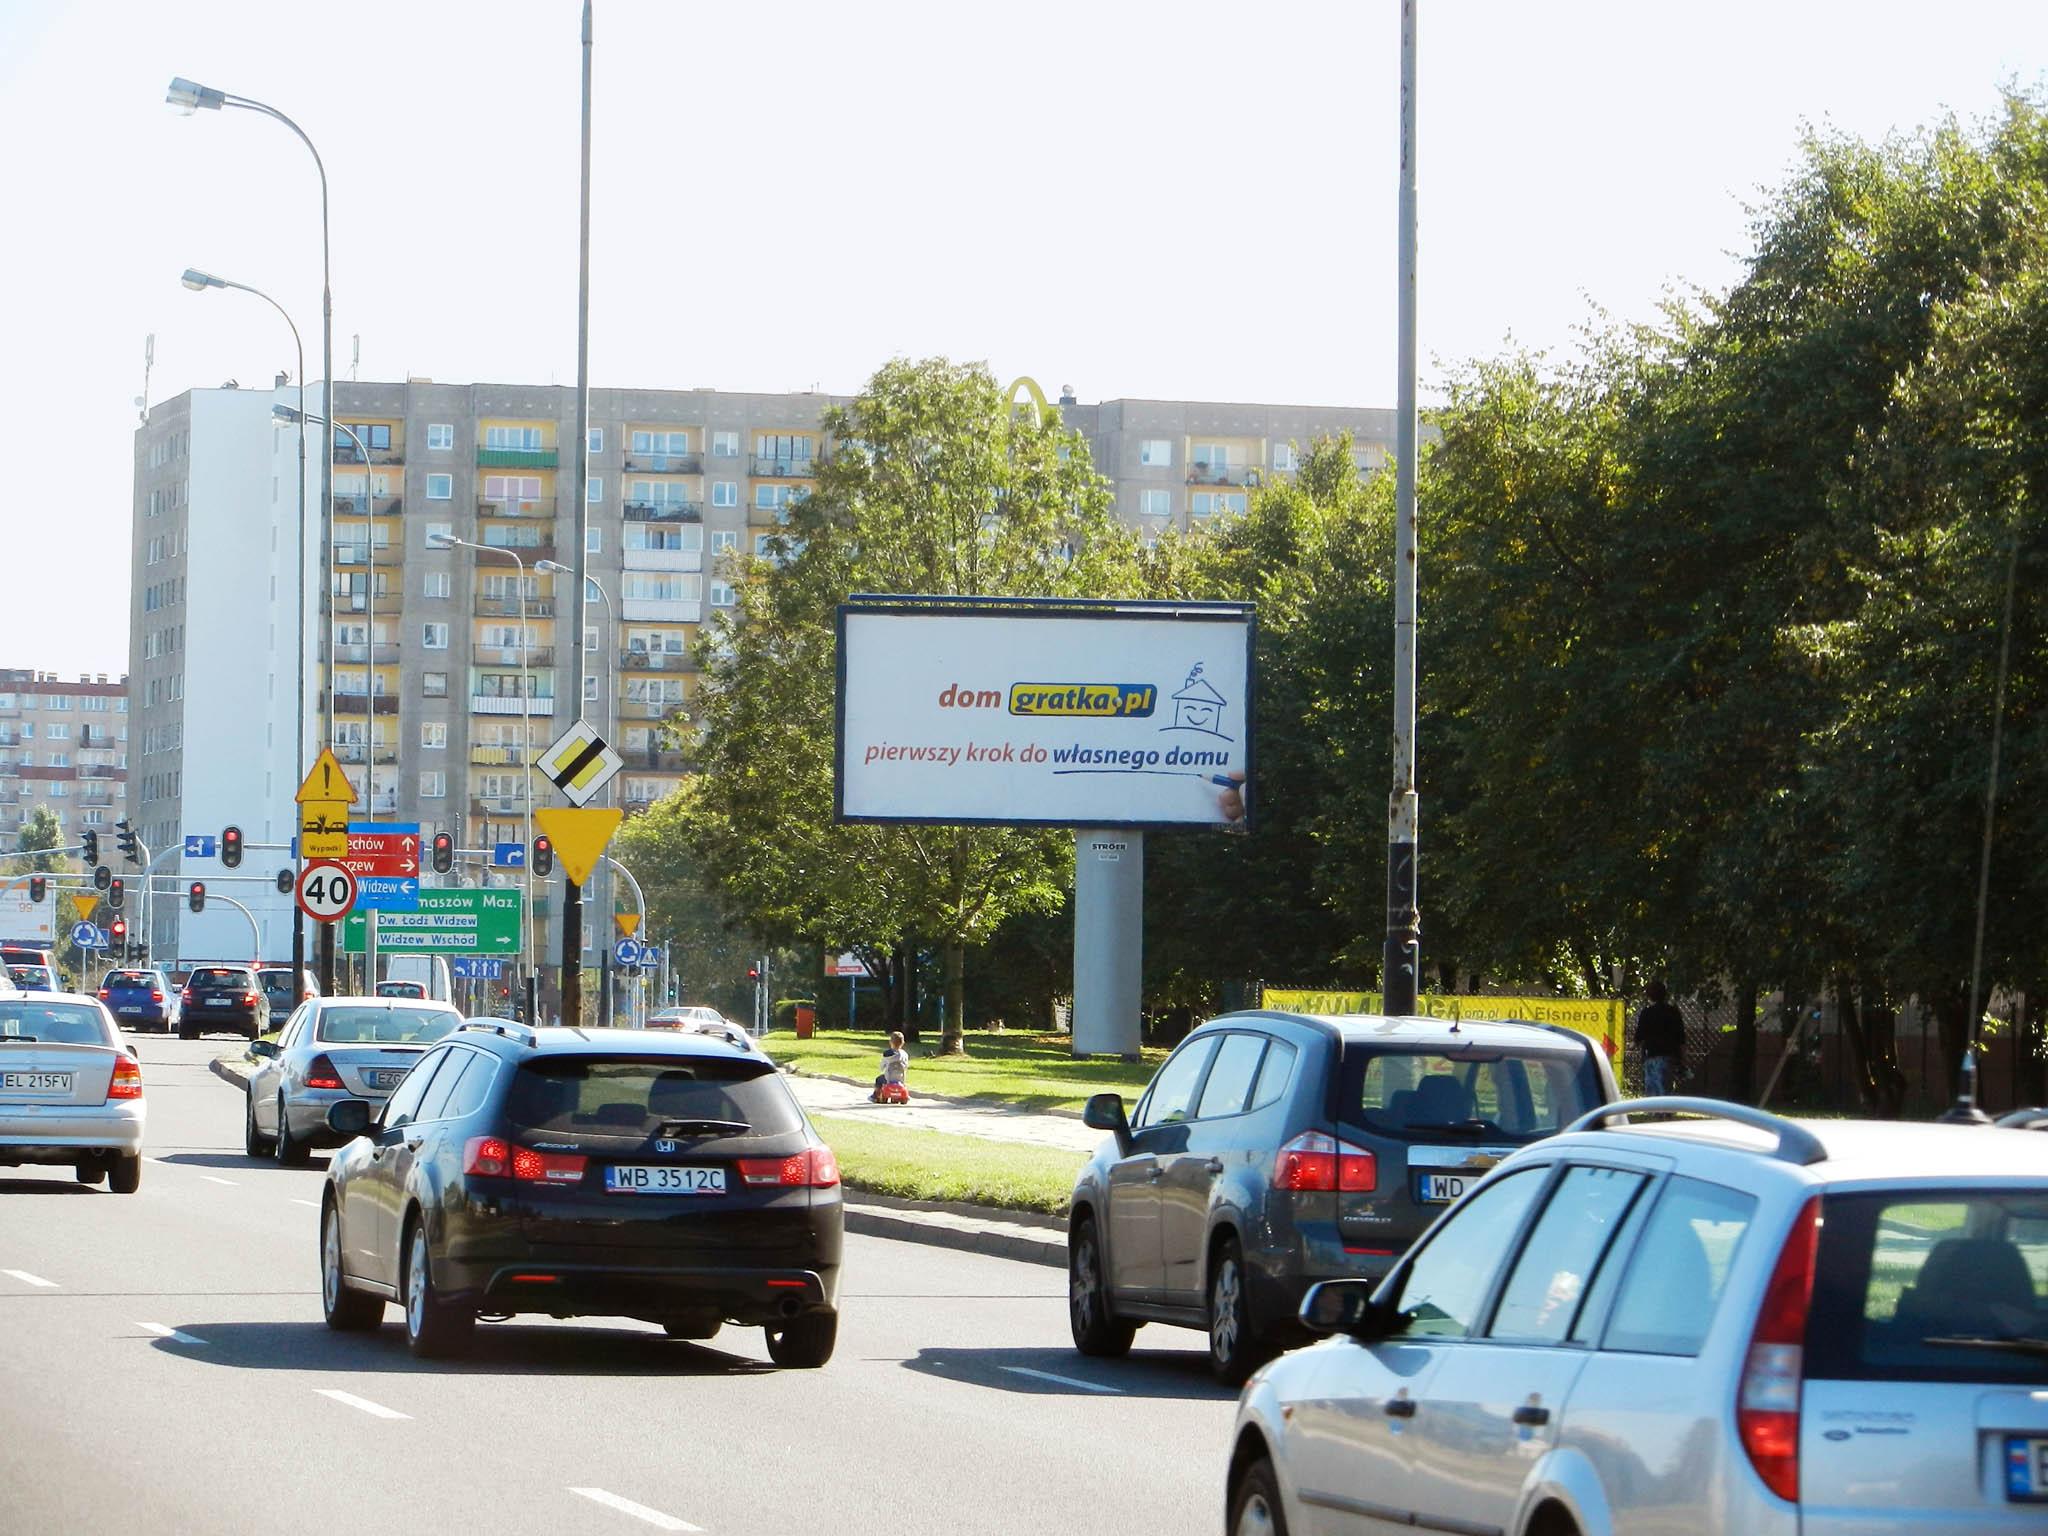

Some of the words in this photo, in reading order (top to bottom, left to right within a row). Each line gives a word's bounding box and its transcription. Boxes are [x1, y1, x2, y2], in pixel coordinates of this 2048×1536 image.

[938, 683, 1001, 708] dom
[1014, 686, 1152, 714] gratka.pl
[864, 741, 962, 767] pierwszy
[966, 742, 1015, 762] krok
[1019, 743, 1048, 763] do
[1052, 743, 1160, 769] własnego
[1164, 745, 1229, 766] domu
[347, 836, 385, 850] echów
[305, 875, 349, 905] 40
[358, 879, 398, 893] Widzew
[482, 894, 517, 908] Maz.
[378, 915, 398, 926] Dw.
[433, 914, 477, 926] Widzew
[379, 934, 424, 944] Widzew
[430, 933, 476, 945] Wschód
[5, 1074, 24, 1087] EL
[28, 1075, 69, 1088] 215FV
[618, 1167, 649, 1187] WB
[657, 1169, 722, 1189] 3512C
[1434, 1177, 1464, 1197] WD
